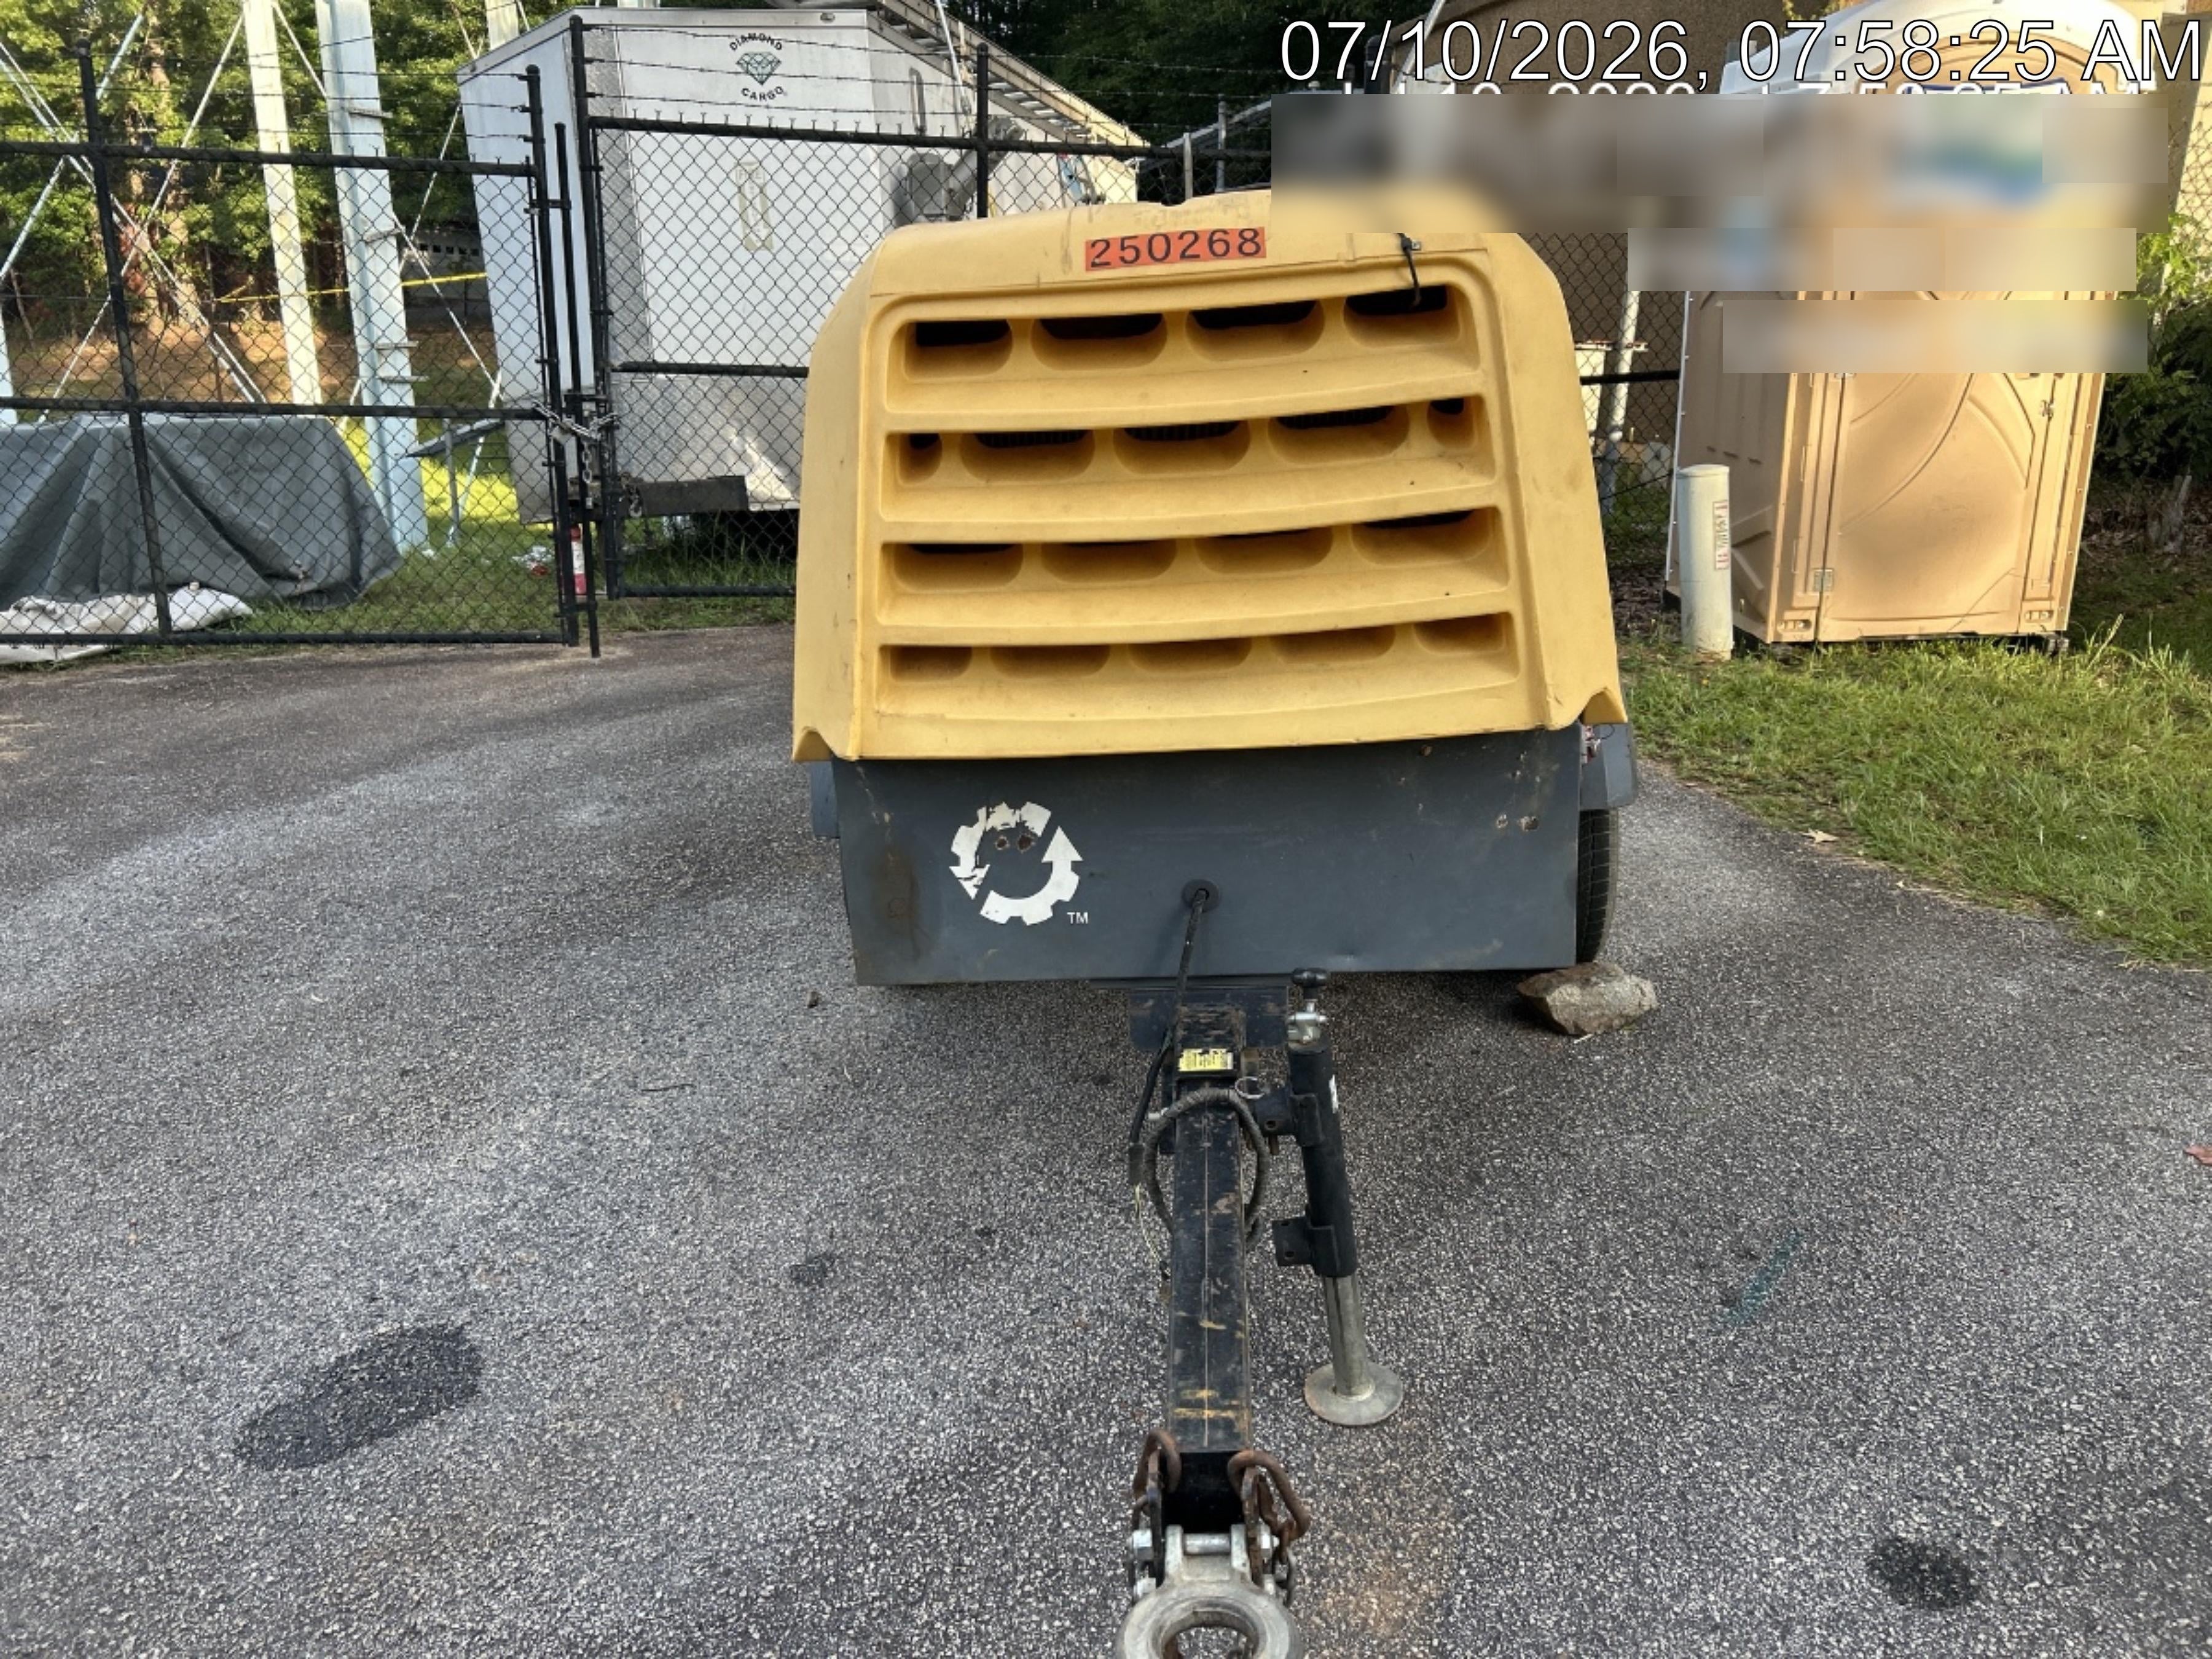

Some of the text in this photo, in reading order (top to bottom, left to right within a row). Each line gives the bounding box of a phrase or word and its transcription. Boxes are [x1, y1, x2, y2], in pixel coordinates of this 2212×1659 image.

[729, 33, 783, 51] DIAMOND
[740, 86, 784, 101] CARGO
[1090, 228, 1261, 268] 250268
[1066, 912, 1088, 924] TM
